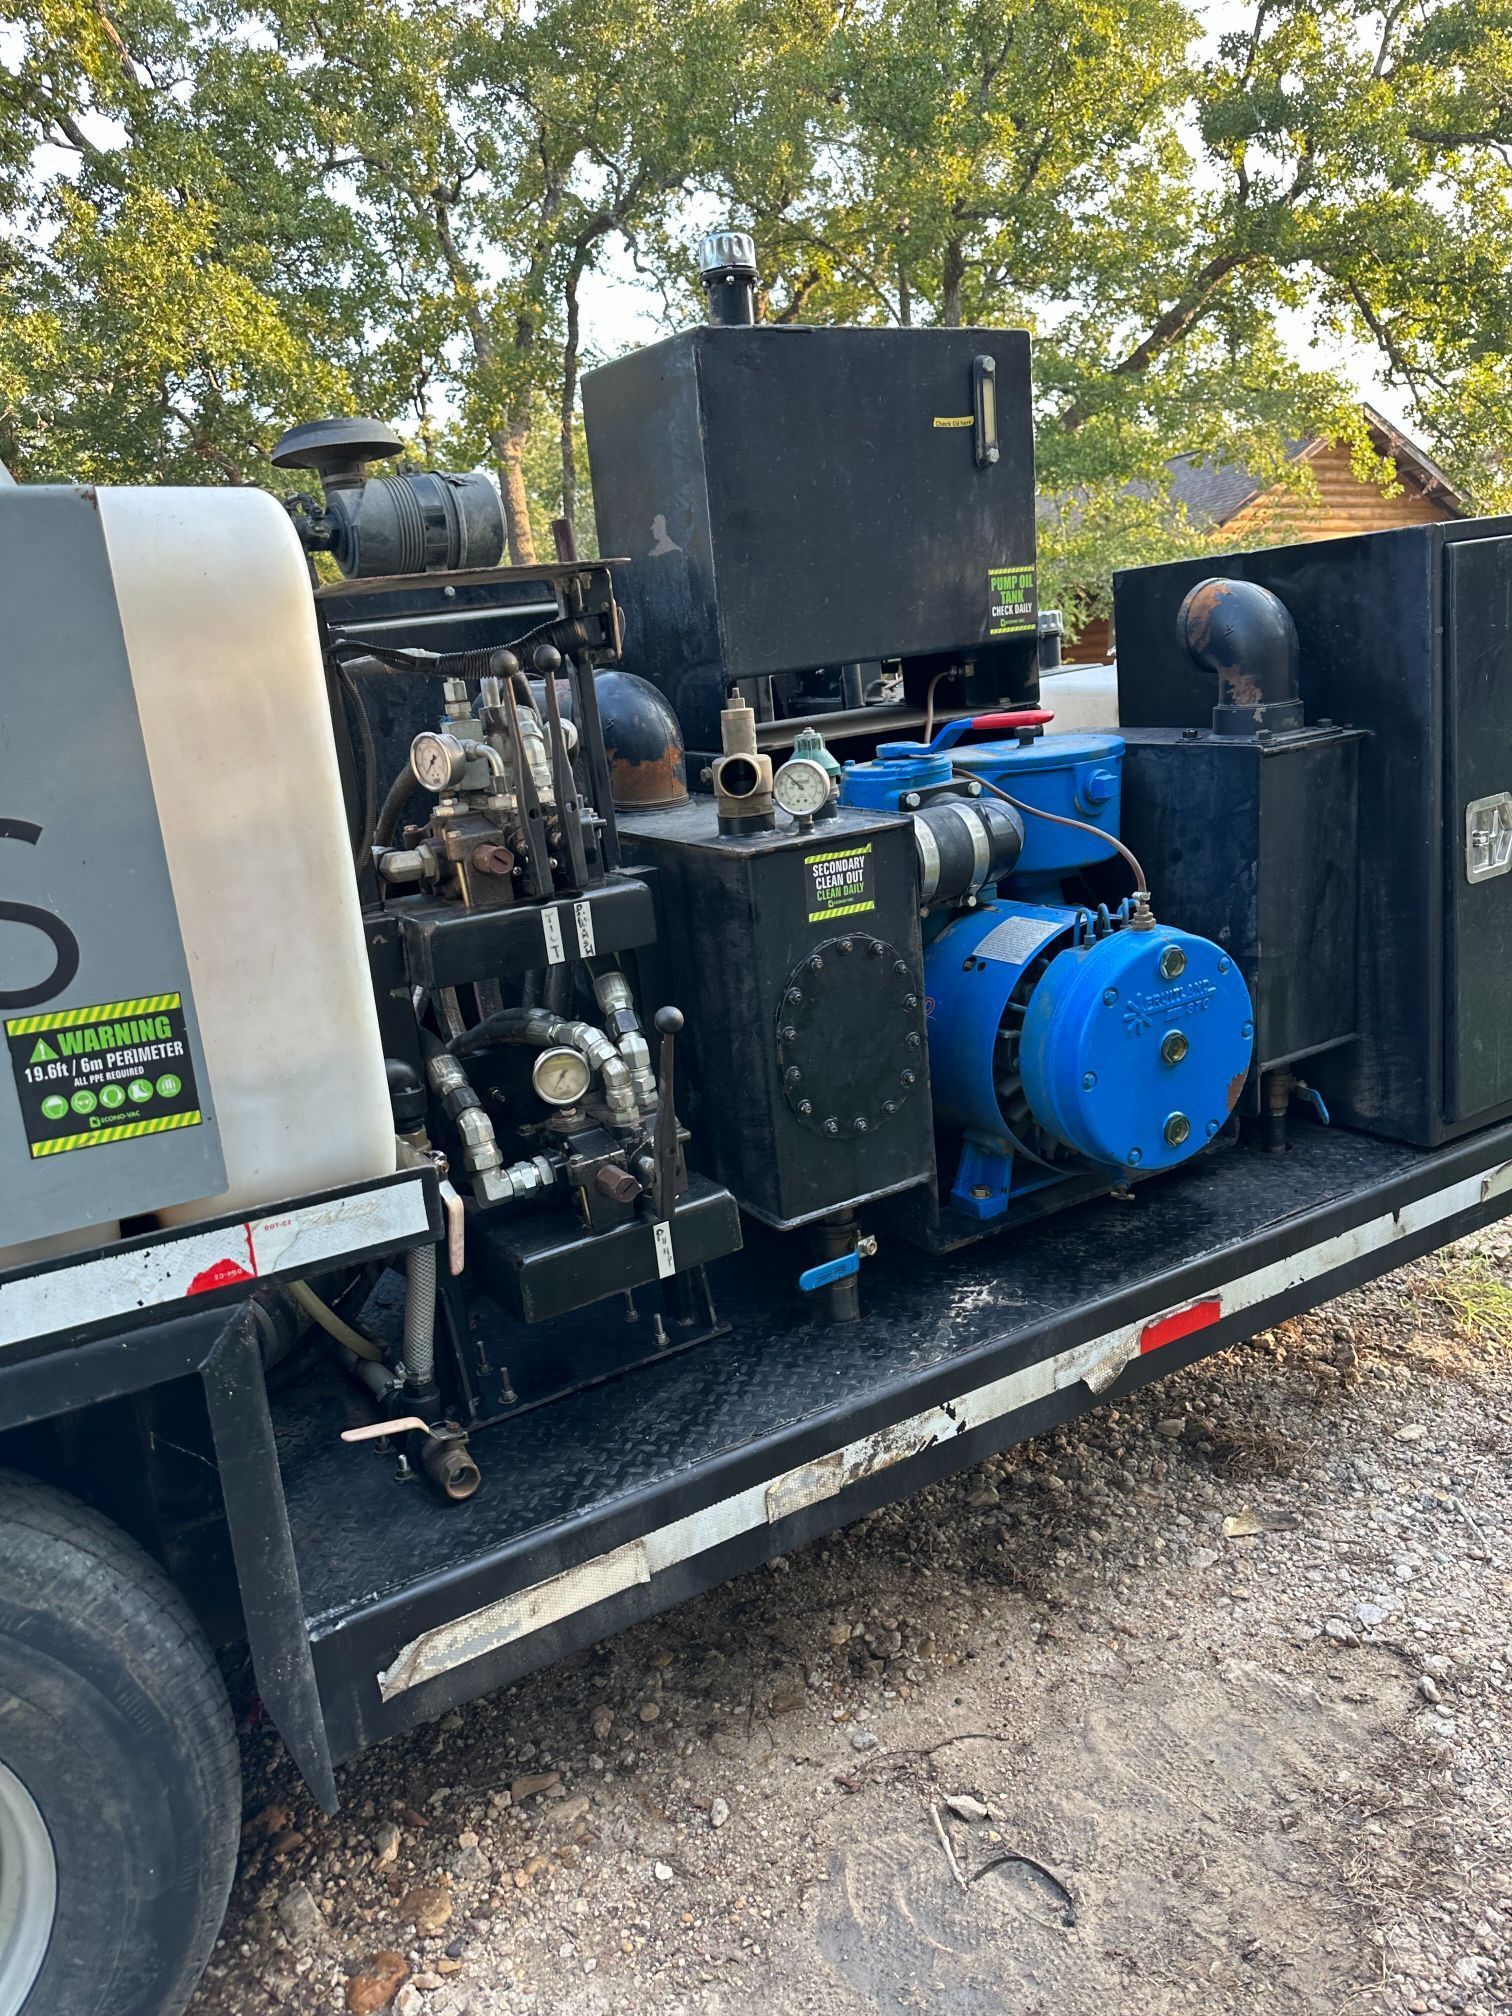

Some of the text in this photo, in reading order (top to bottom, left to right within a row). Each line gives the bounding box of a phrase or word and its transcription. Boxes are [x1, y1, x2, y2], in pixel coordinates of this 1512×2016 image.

[990, 574, 1034, 592] PUMP OIL
[1000, 590, 1025, 605] TANK
[991, 602, 1033, 617] CHECK DAILY
[812, 856, 865, 878] SECONDARY
[815, 870, 864, 890] CLEAN OUT
[816, 882, 865, 901] CLEAN DAILY
[57, 1015, 172, 1057] WARNING
[24, 1040, 184, 1084] 19.6ft / 6m PERIMETER
[74, 1067, 145, 1087] ALL PPE REQUIRED
[264, 1219, 292, 1231] DOT-C2
